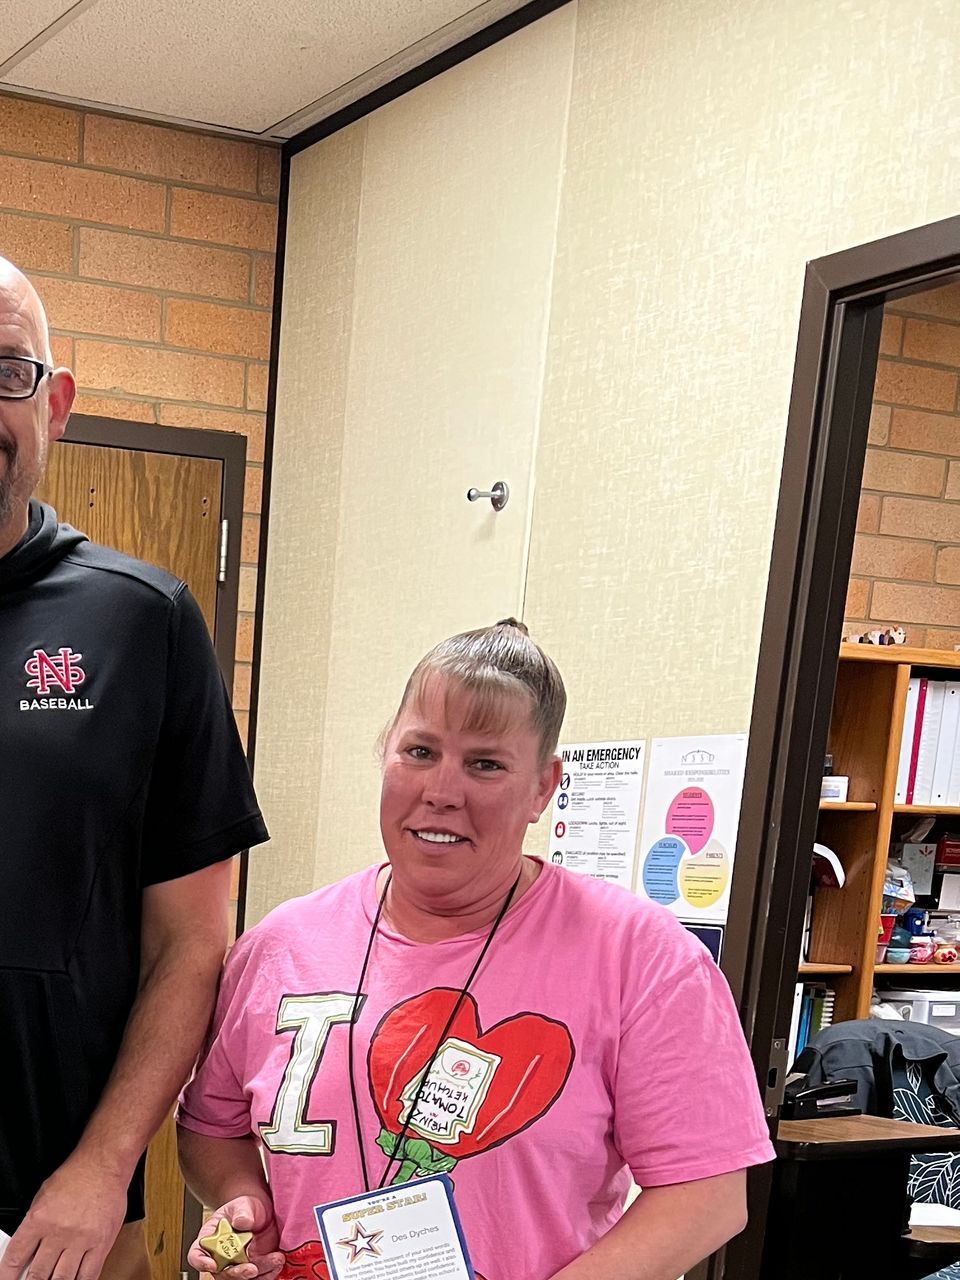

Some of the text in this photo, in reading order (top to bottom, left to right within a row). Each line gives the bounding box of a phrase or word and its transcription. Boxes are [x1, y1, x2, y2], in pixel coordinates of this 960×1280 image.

[20, 698, 94, 711] BASEBALL
[562, 746, 641, 762] IN AN EMERGENCY
[596, 761, 620, 769] ACTION
[258, 990, 368, 1156] I
[418, 1090, 465, 1119] TOMATO
[411, 1108, 449, 1133] HEINZ
[341, 1192, 428, 1223] SUPER STAR!
[391, 1225, 440, 1243] Des Dyches
